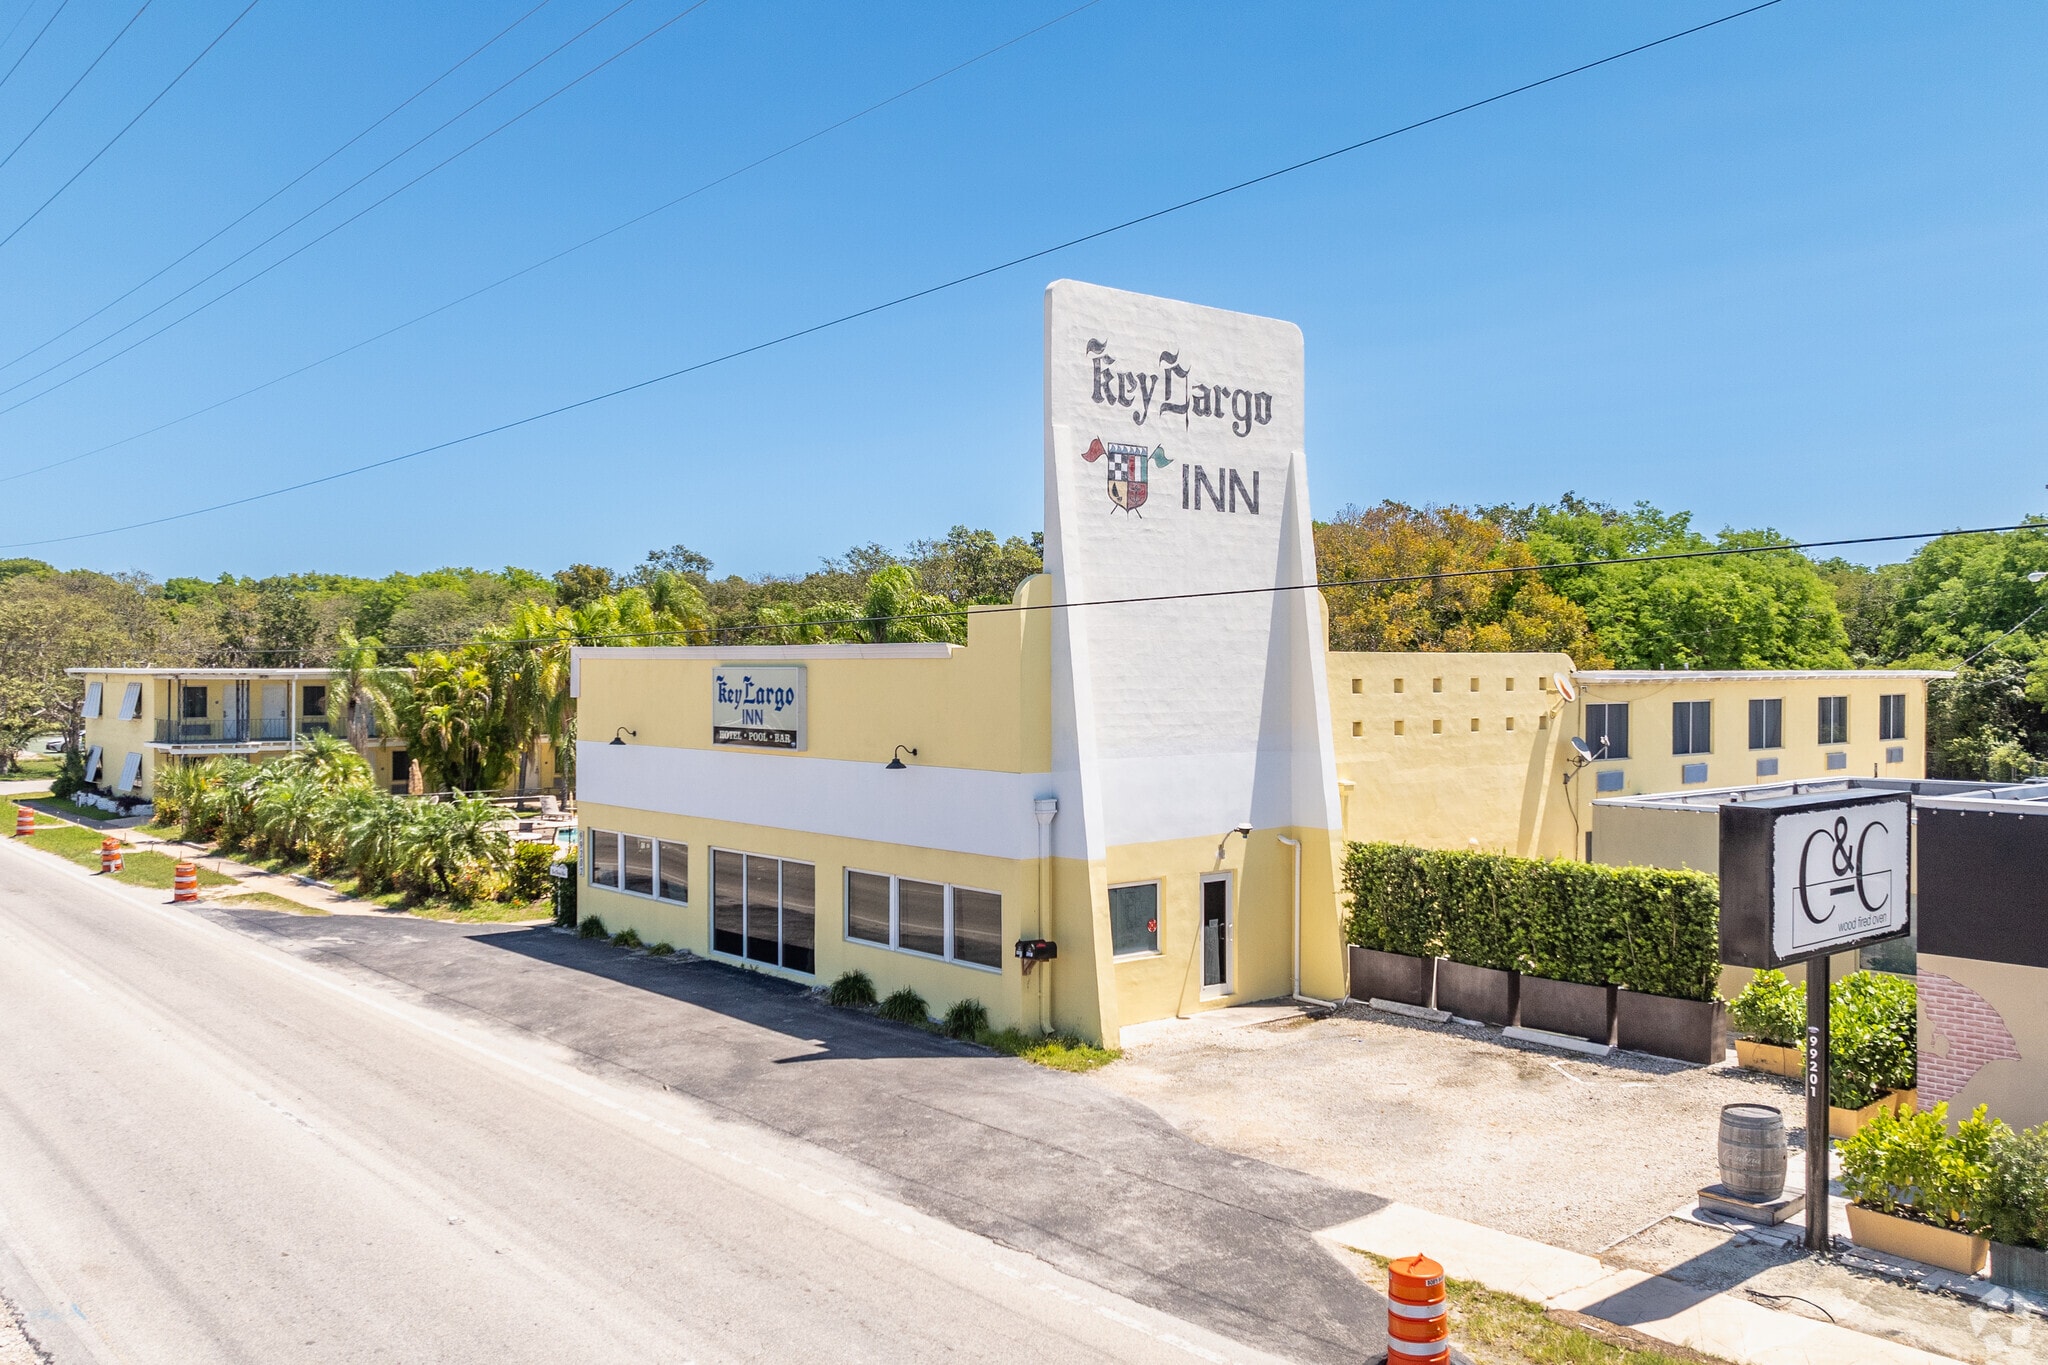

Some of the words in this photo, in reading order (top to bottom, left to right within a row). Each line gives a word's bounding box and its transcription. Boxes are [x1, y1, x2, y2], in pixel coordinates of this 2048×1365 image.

[1086, 337, 1159, 426] Key
[1158, 349, 1273, 439] Largo
[1182, 463, 1260, 515] INN
[716, 675, 742, 710] Key
[743, 675, 795, 712] Largo
[742, 709, 763, 725] INN
[719, 730, 742, 740] HOTEL
[748, 732, 768, 742] POOL
[774, 733, 791, 743] BAR
[1838, 916, 1857, 932] wood
[1858, 914, 1872, 928] fired
[1872, 912, 1888, 926] oven
[1809, 1036, 1819, 1097] 99201
